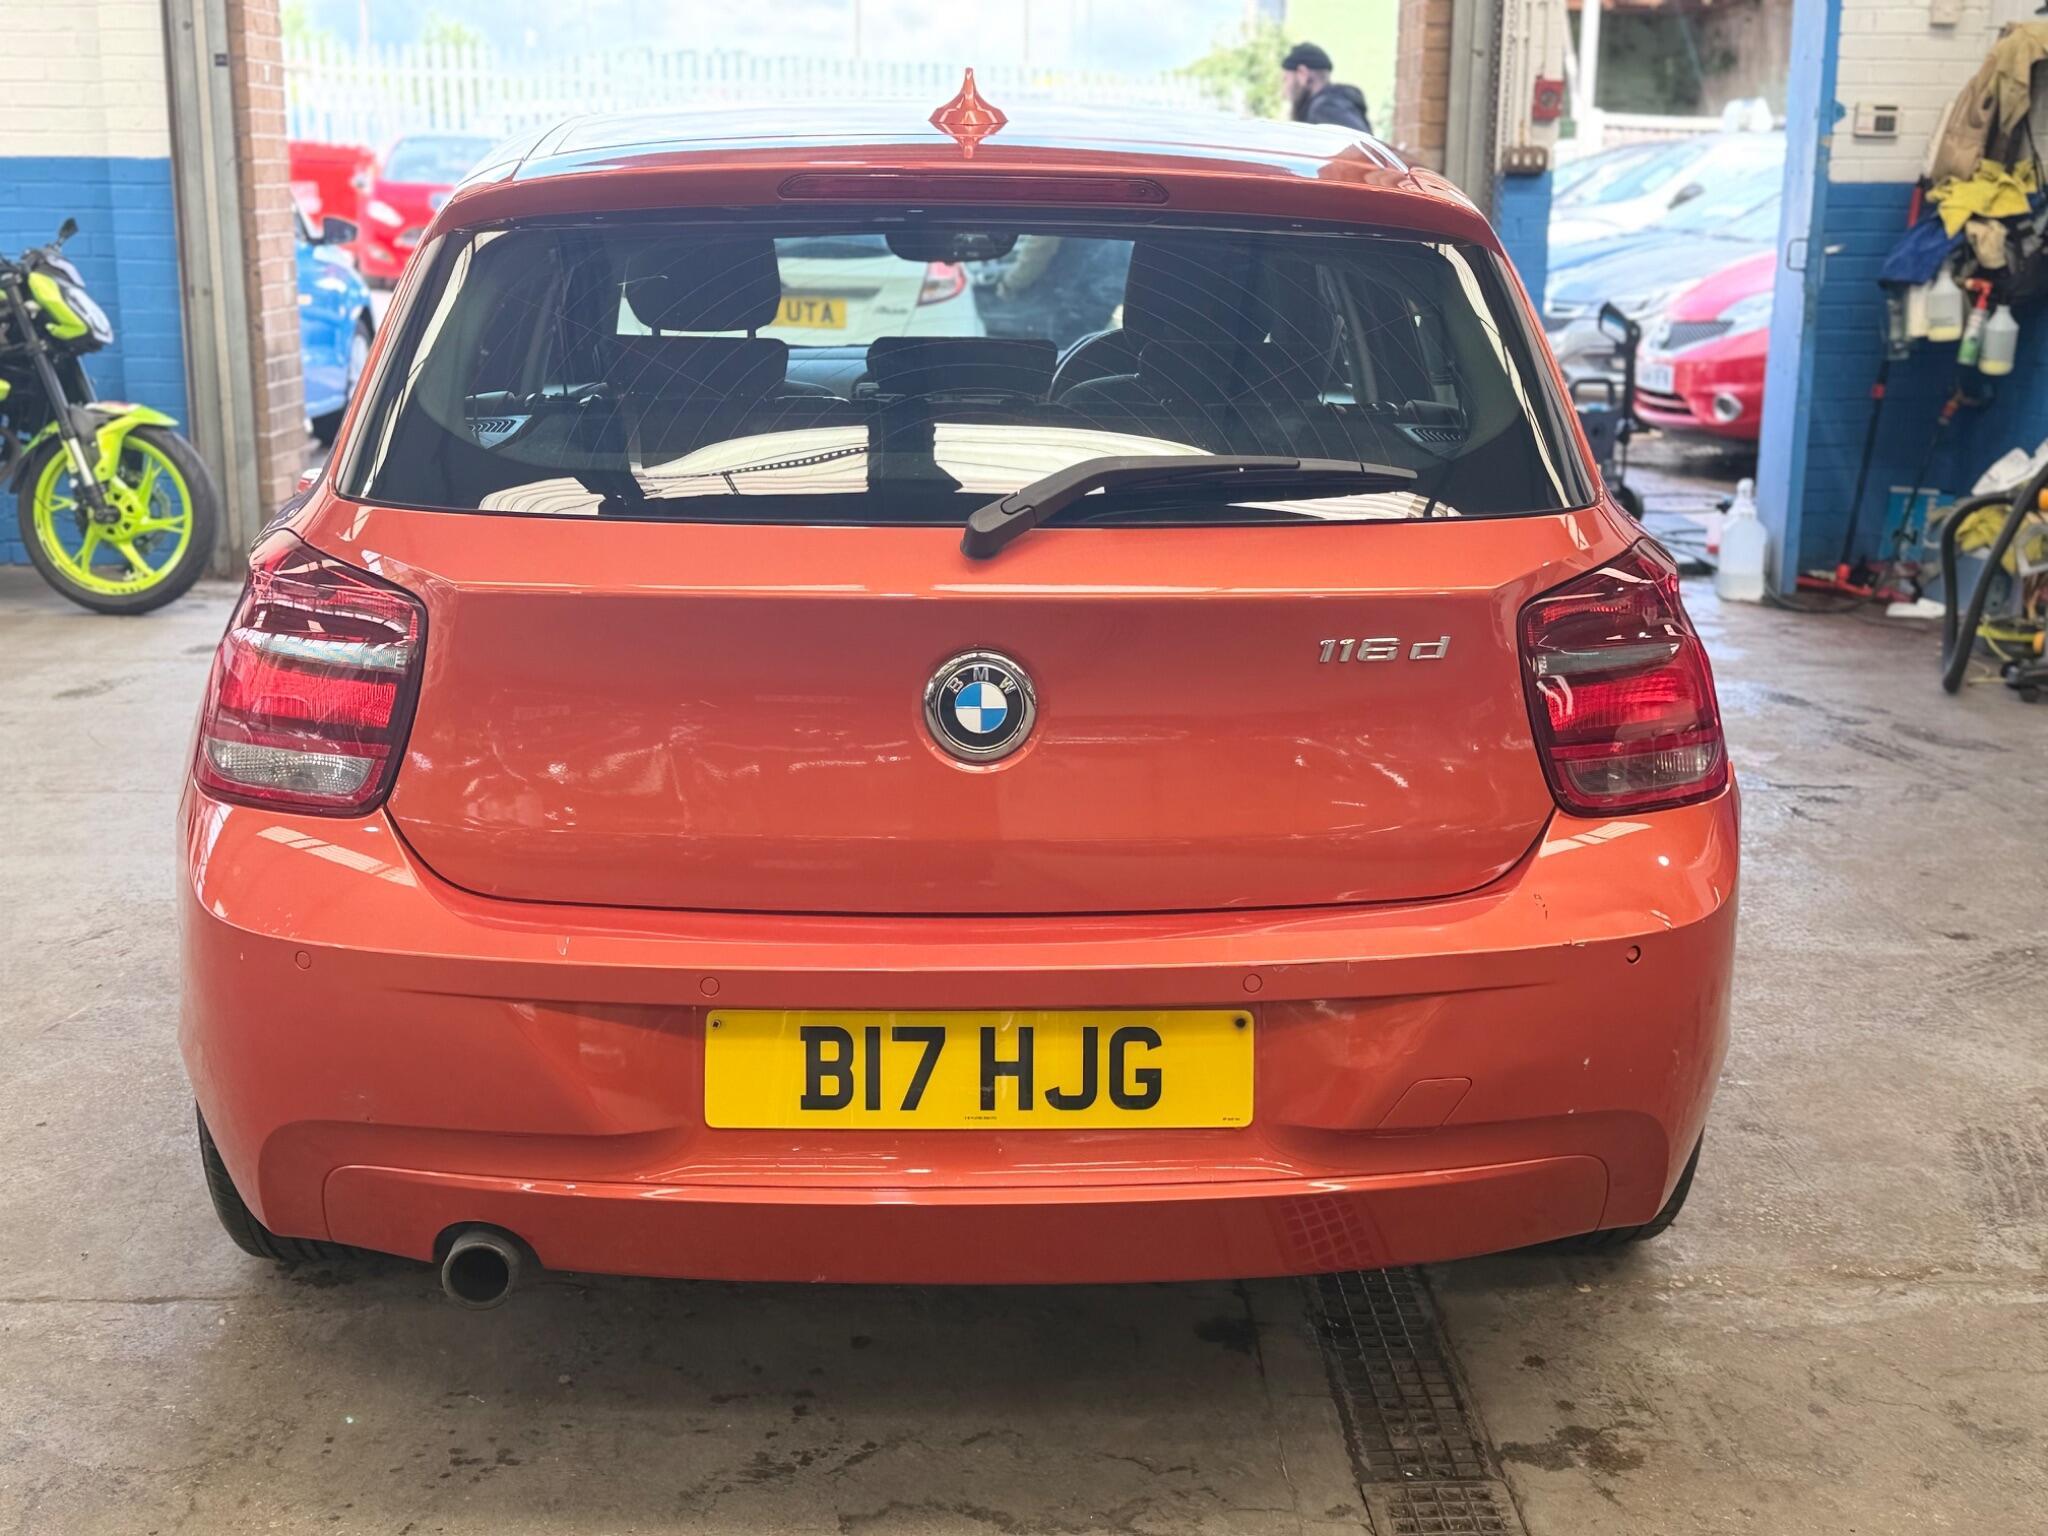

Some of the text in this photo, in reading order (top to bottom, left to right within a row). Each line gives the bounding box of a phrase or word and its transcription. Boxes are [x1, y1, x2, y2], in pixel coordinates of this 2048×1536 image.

[786, 302, 834, 323] UTA
[1318, 635, 1451, 663] 116 d
[946, 666, 1018, 695] BMW
[800, 1026, 1163, 1111] B17 HJG
